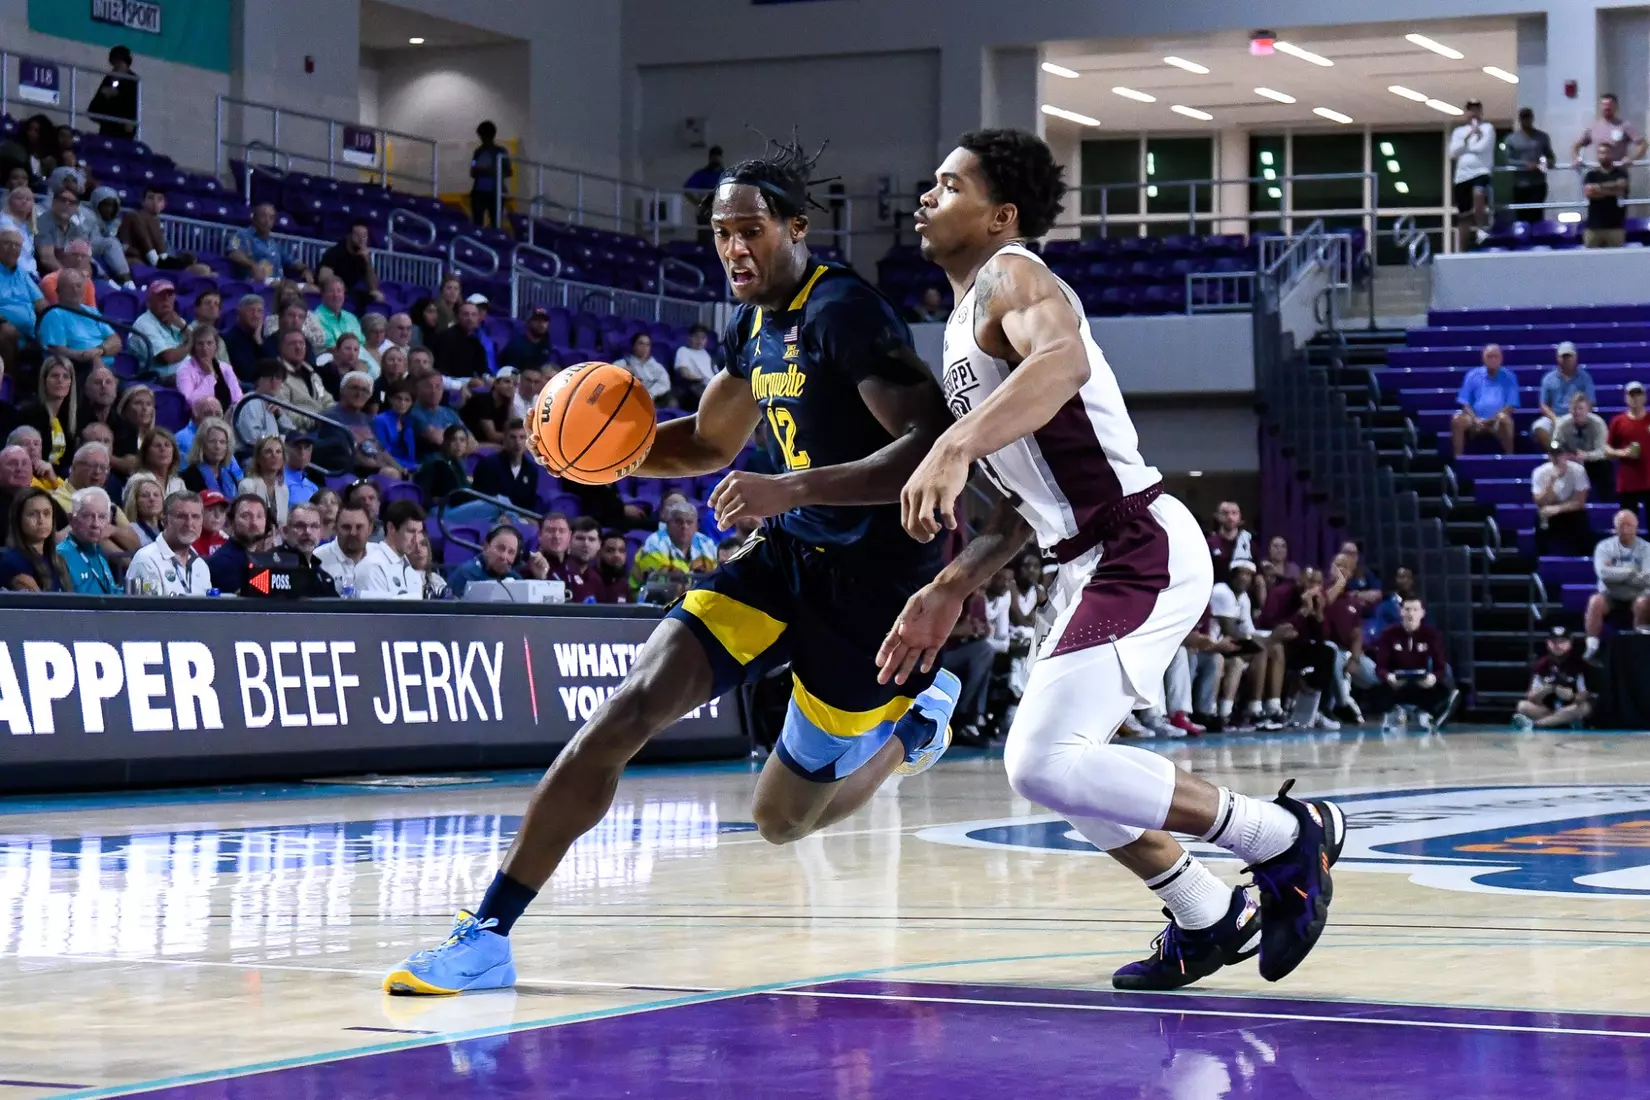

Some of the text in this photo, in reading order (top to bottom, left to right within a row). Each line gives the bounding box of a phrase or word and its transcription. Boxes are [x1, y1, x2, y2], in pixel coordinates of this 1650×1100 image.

[34, 67, 53, 85] 118
[751, 363, 807, 407] Marquette
[767, 407, 811, 470] 12
[271, 573, 292, 590] POSS.
[553, 643, 647, 677] WHAT'
[234, 641, 360, 729] BEEF
[372, 641, 504, 725] JERKY
